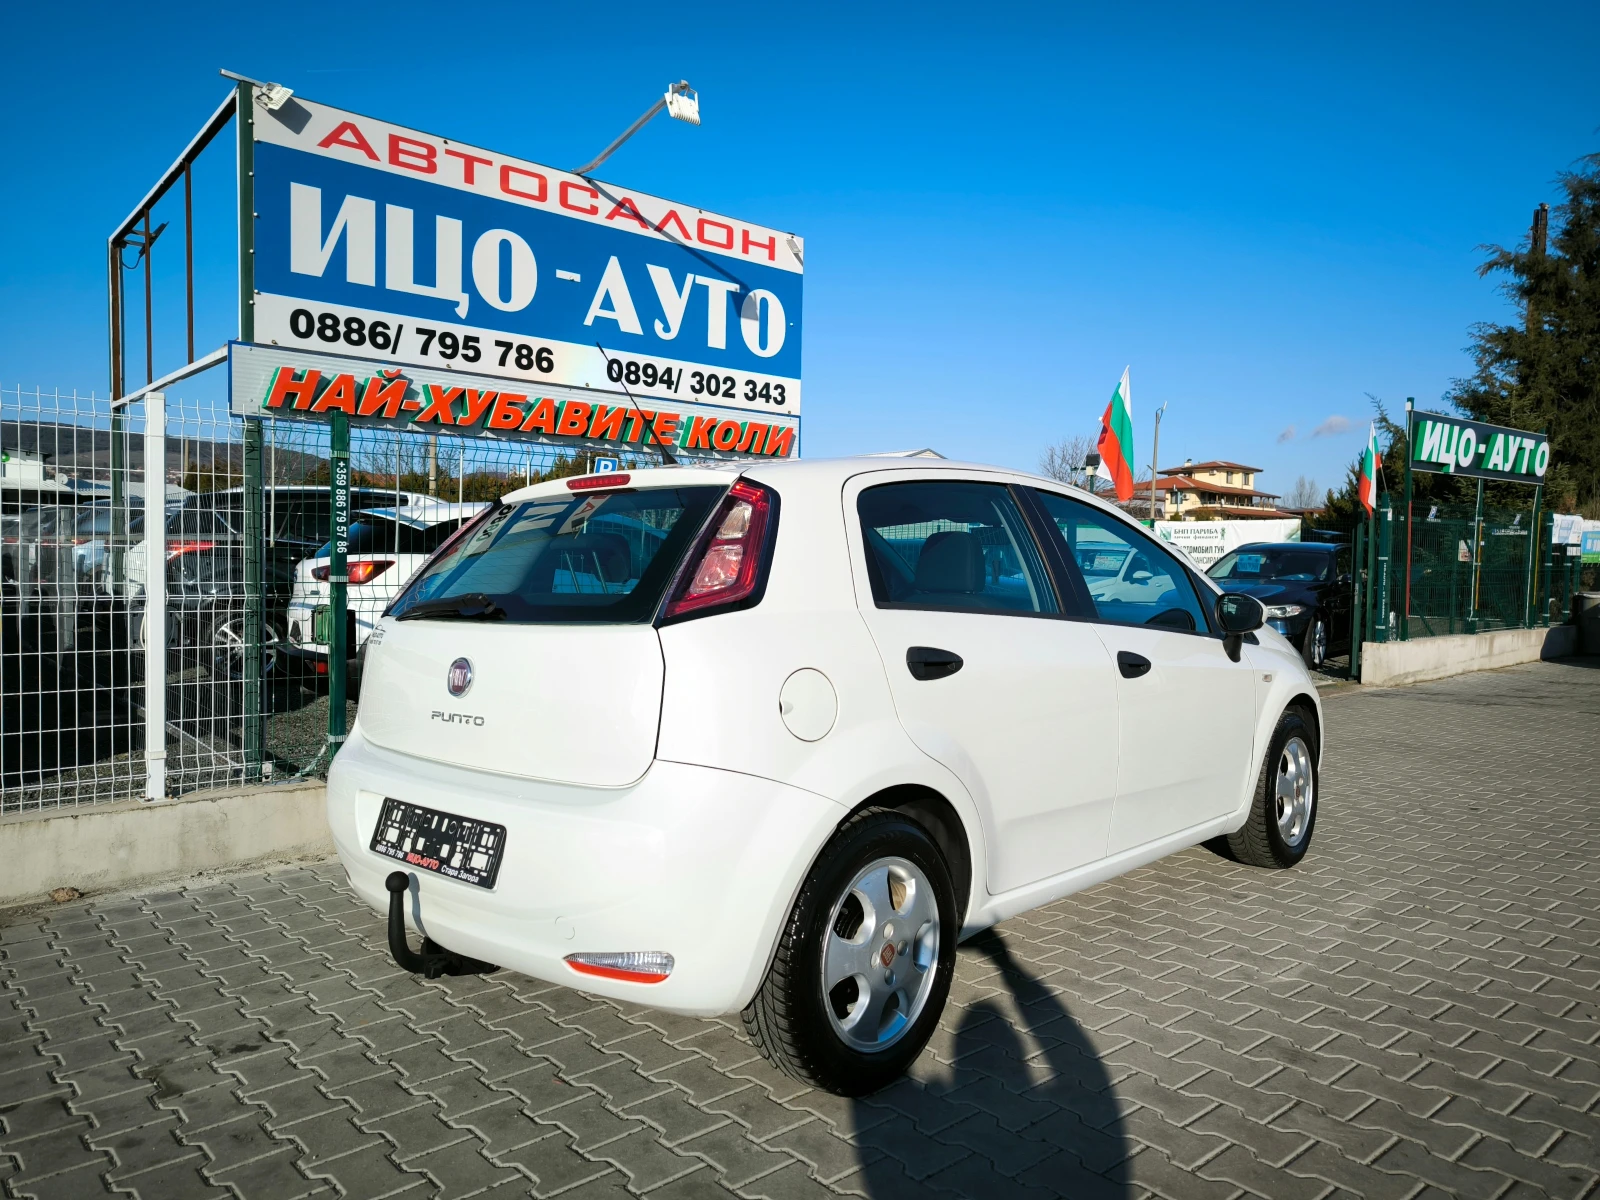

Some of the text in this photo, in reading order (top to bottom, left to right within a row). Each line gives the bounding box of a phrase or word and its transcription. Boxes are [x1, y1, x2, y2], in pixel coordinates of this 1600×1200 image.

[316, 121, 776, 261] АВТОСАЛОН
[289, 308, 555, 373] 0886/ 795 786
[606, 358, 786, 405] 0894/ 302 343
[264, 366, 794, 457] НАЙ-ХУБАВИТЕ КОЛИ
[1420, 421, 1550, 477] ИЦО-АУТО
[336, 461, 347, 554] +359 886 79 57 86
[1214, 545, 1225, 554] ТУК
[431, 710, 485, 726] PUNTO
[441, 864, 459, 877] Стара
[458, 868, 479, 884] Загора
